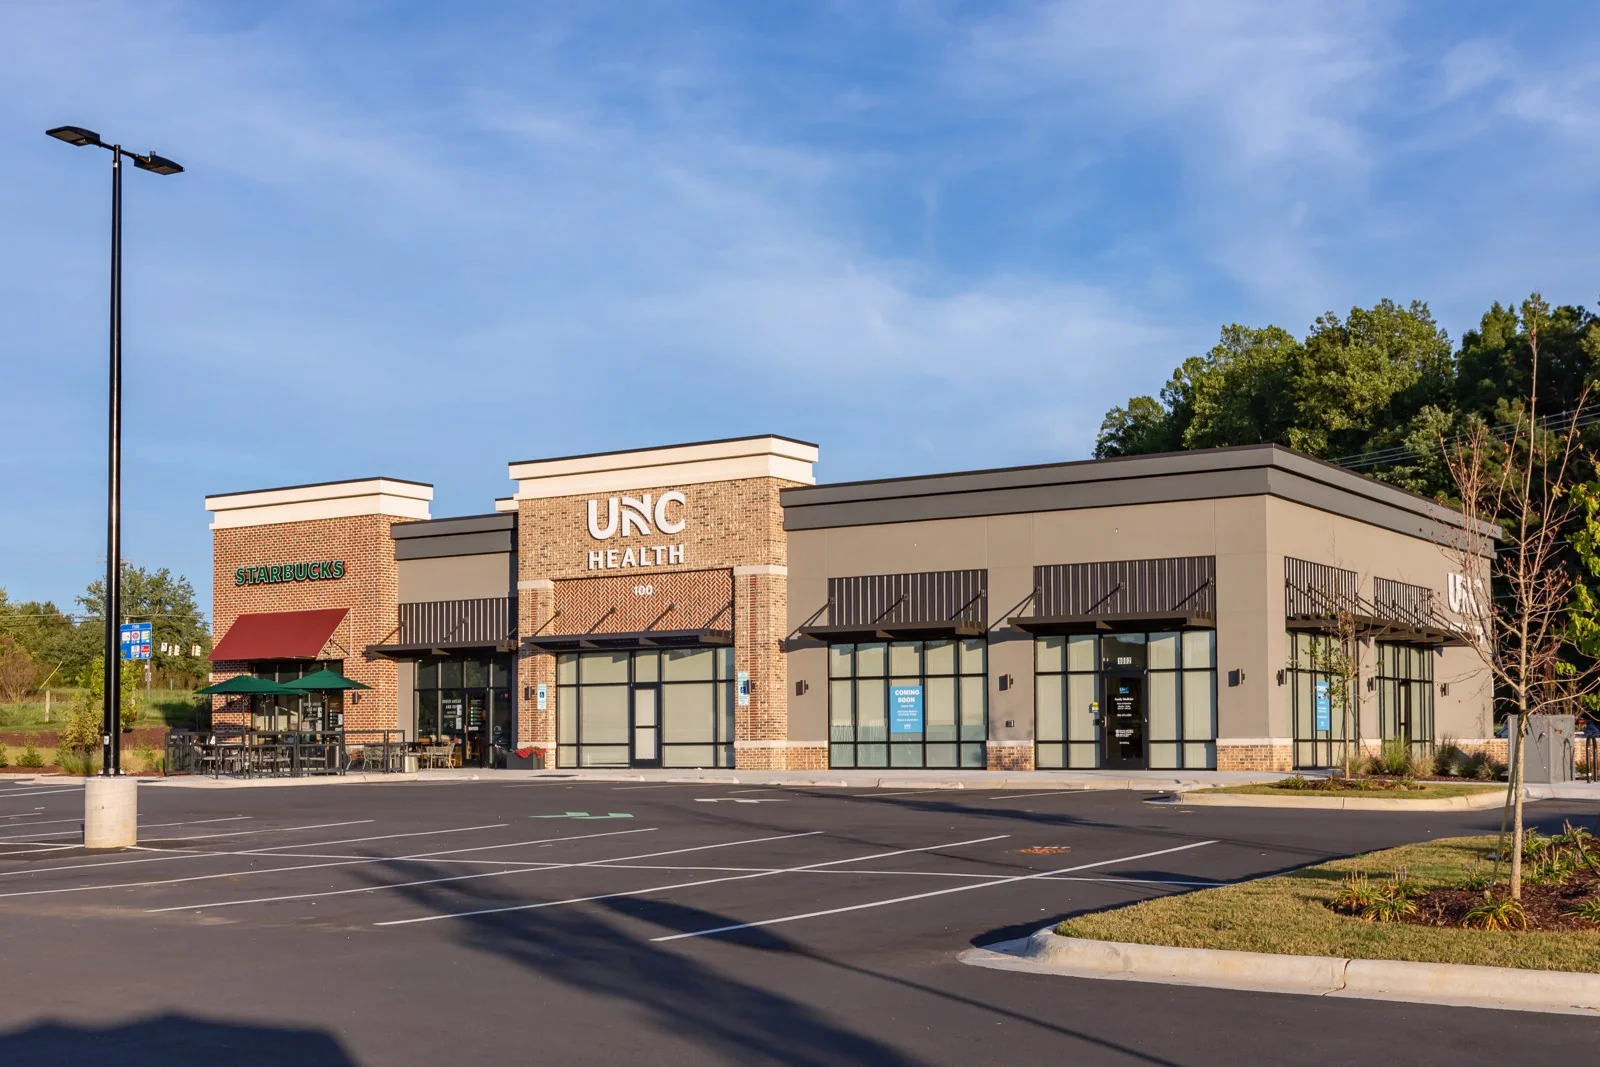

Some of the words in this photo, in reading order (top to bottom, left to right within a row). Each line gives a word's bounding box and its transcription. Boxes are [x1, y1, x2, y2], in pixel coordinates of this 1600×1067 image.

[587, 491, 686, 540] UNC
[588, 544, 684, 570] HEALTH
[235, 560, 345, 586] STARBUCKS
[634, 585, 653, 596] 100
[897, 696, 916, 704] SOON
